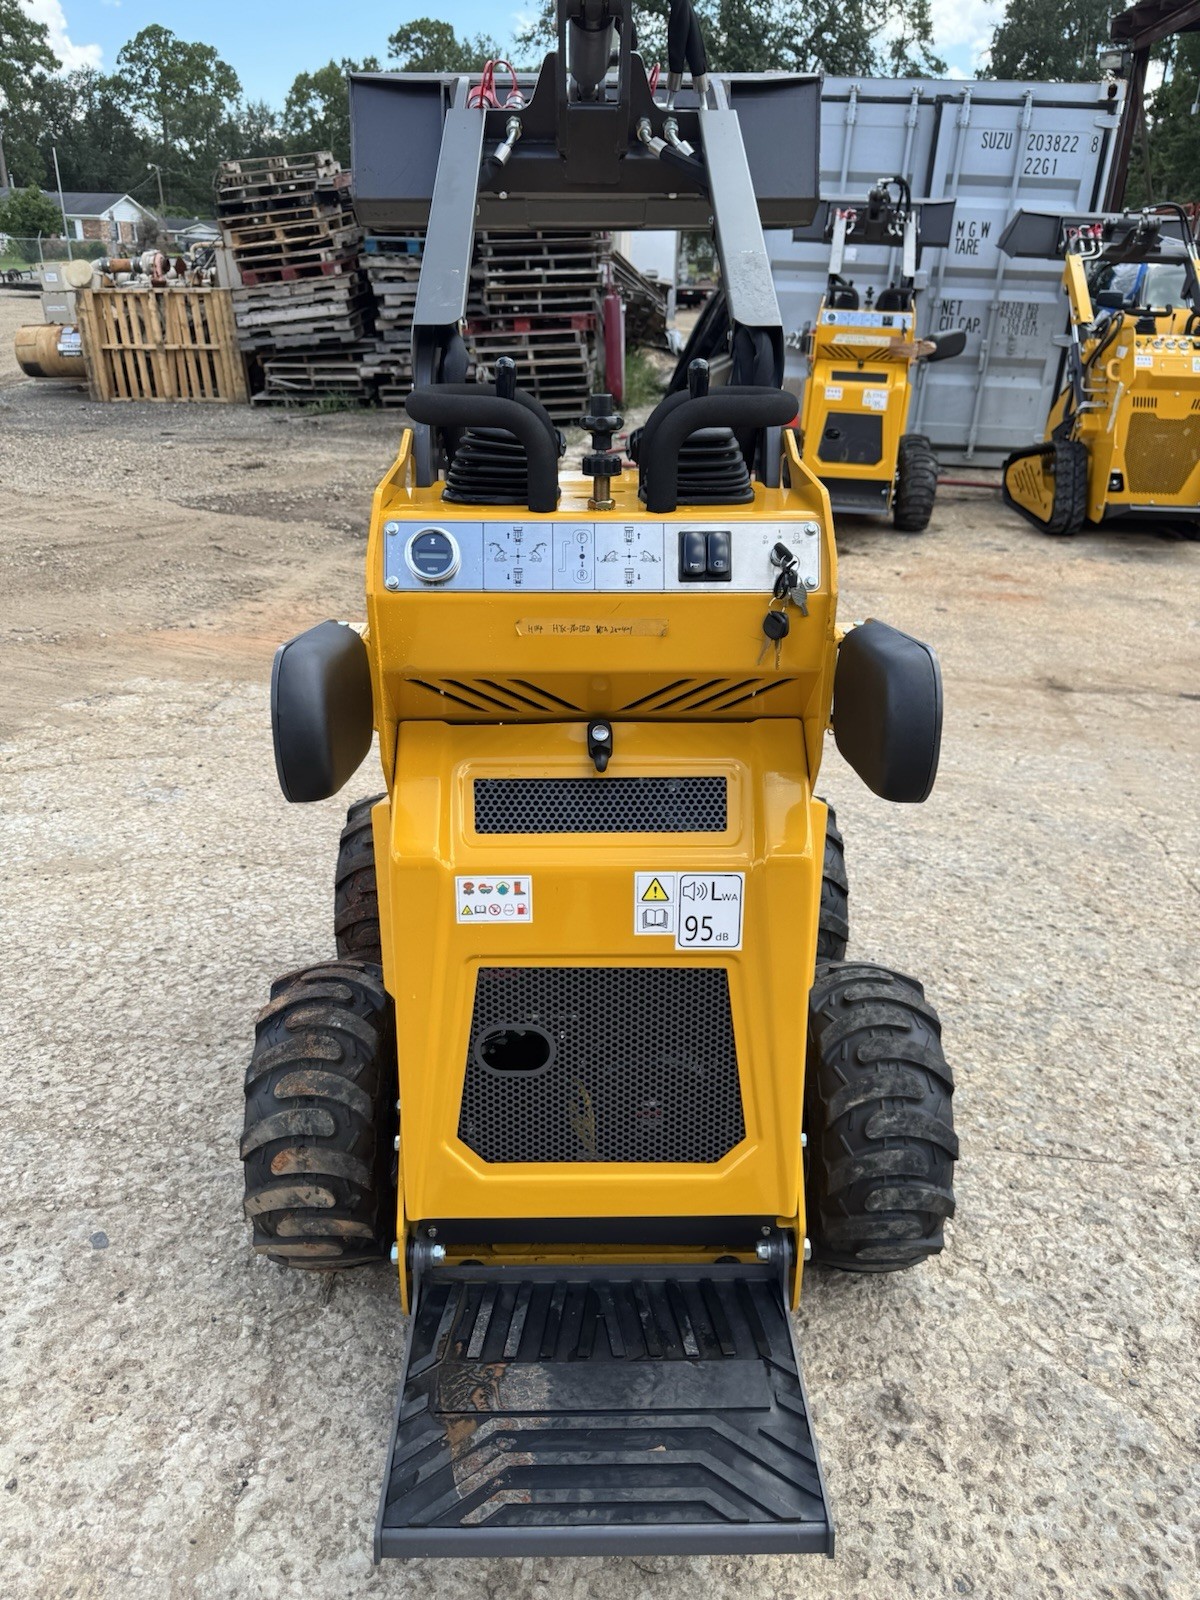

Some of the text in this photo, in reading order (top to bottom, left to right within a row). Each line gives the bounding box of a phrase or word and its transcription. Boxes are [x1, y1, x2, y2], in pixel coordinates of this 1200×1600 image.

[981, 131, 1099, 153] SUZU 203822 8
[1023, 157, 1058, 176] 22G1
[954, 238, 980, 255] TARE
[941, 300, 963, 316] NET
[685, 915, 729, 942] 95 dB
